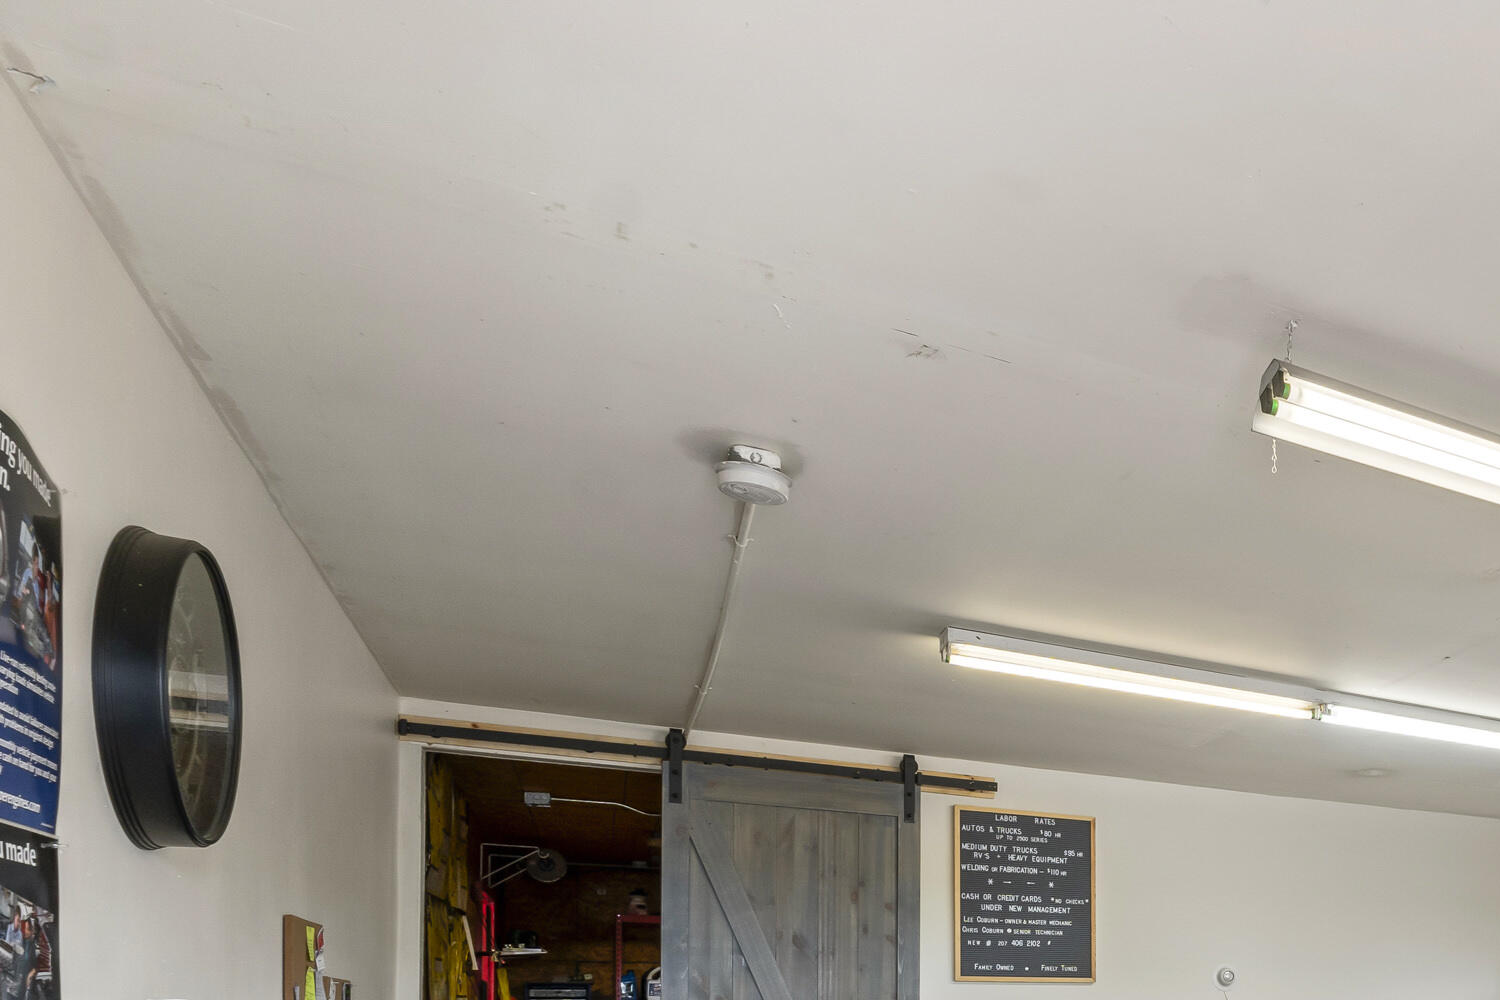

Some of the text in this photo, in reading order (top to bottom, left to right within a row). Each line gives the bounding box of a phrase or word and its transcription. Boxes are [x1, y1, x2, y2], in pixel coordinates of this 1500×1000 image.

[17, 448, 32, 481] you
[995, 814, 1056, 825] LABOR RATES
[961, 824, 985, 832] AUTOS
[996, 826, 1022, 835] TRUCKS
[5, 842, 37, 867] made
[990, 844, 1007, 852] DUTY
[1012, 846, 1038, 854] TRUCKS
[1007, 853, 1028, 861] HEAVY
[1031, 855, 1068, 864] EQUIPMENT
[961, 863, 989, 872] WELDING
[999, 865, 1038, 874] FABRICATION
[961, 892, 980, 900] CASH
[997, 894, 1020, 902] CREDIT
[1020, 895, 1042, 903] CARDS
[980, 903, 1071, 914] UNDER NEW MANAGEMENT
